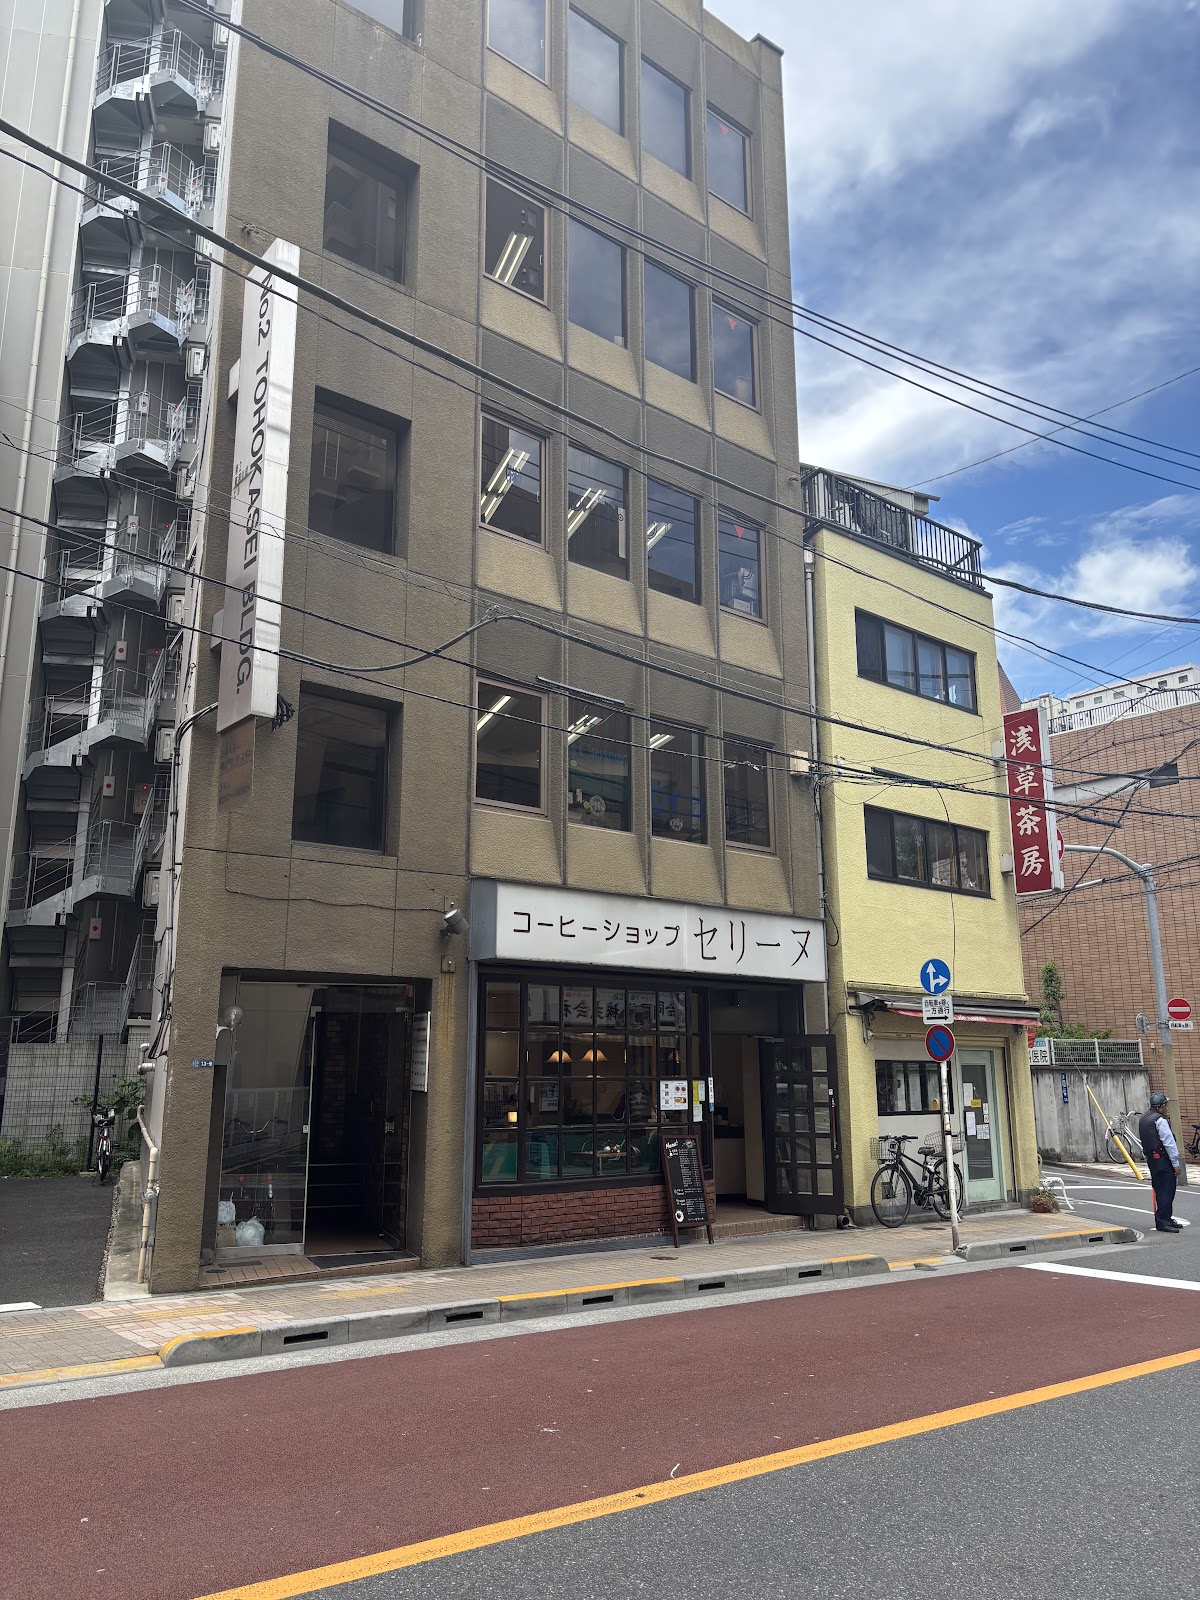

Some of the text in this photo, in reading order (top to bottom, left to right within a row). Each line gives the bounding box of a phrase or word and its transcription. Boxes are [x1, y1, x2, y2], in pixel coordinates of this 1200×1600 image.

[243, 350, 270, 570] TOHOKASEI
[236, 580, 255, 694] BLDG.
[1010, 725, 1045, 876] 浅草茶房
[513, 911, 811, 967] コーヒーショップ セリーヌ
[924, 999, 950, 1007] 自転車を除く
[924, 1006, 950, 1015] 一方通行
[1028, 1049, 1048, 1063] 医院
